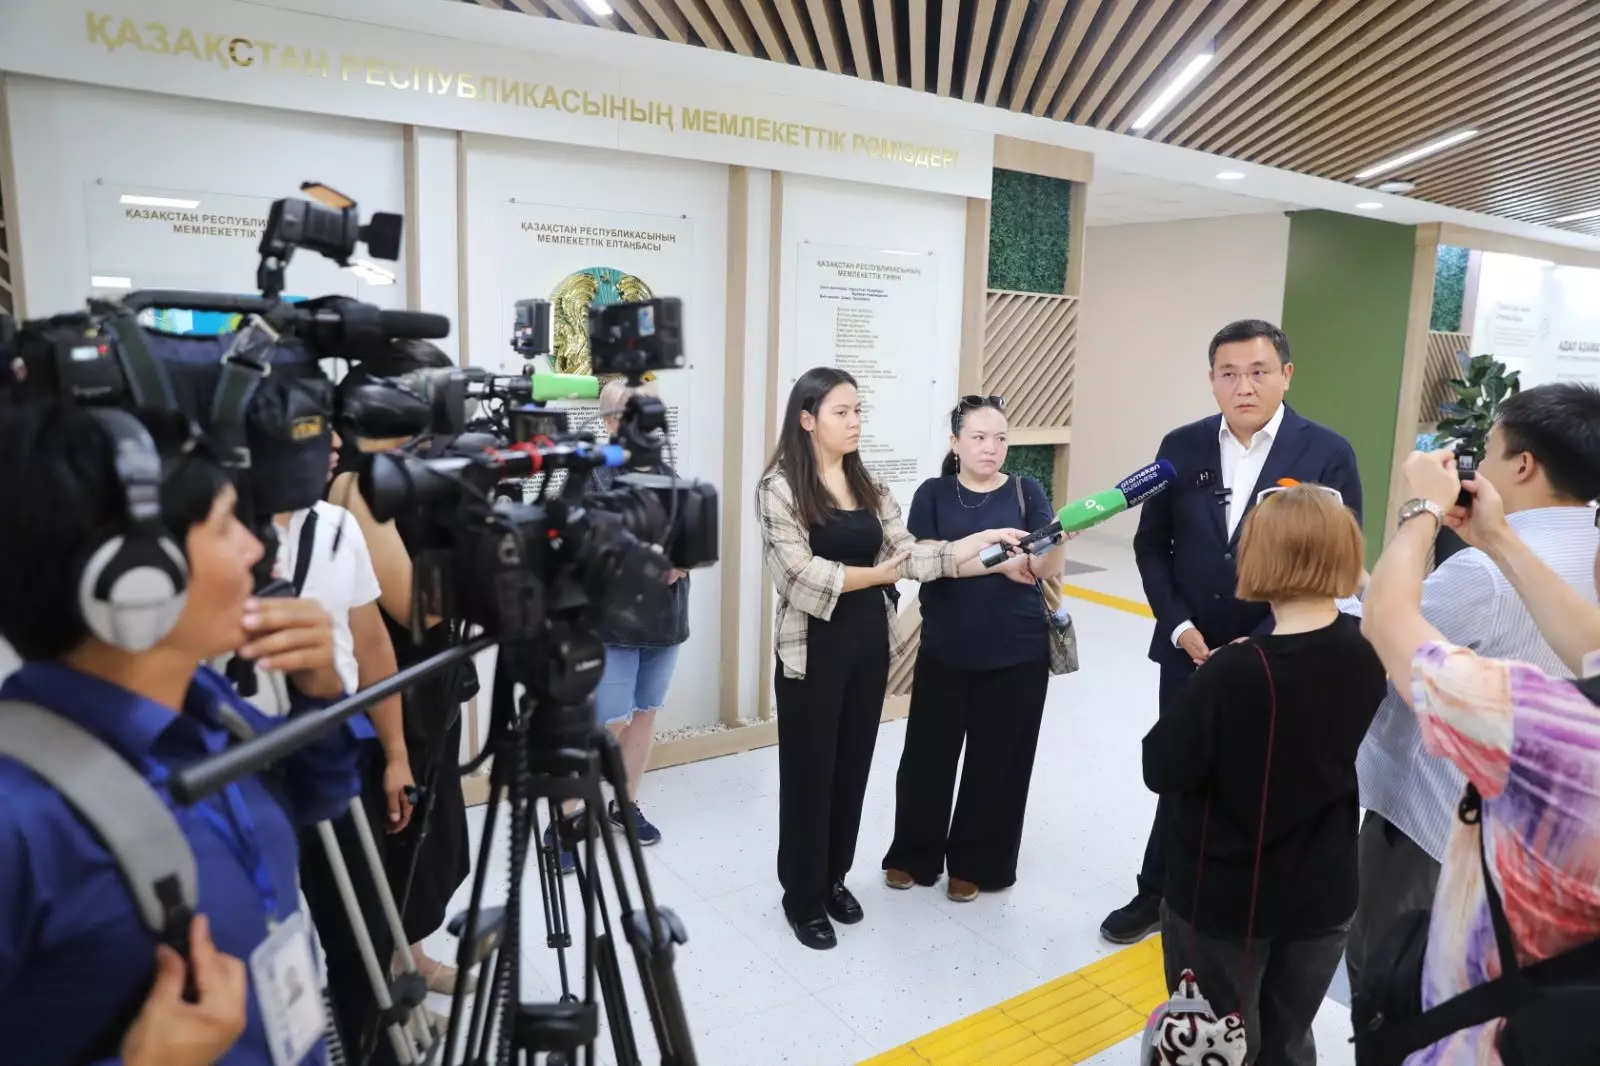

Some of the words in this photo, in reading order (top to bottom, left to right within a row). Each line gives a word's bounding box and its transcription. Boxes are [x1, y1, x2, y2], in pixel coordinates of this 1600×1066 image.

[86, 11, 328, 79] ҚАЗАҚСТАН
[341, 54, 674, 133] РЕСПУБЛИКАСЫНЫҢ
[682, 107, 847, 152] МЕМЛЕКЕТТІК
[125, 208, 199, 223] ҚАЗАҚСТАН
[202, 214, 268, 228] РЕСПУБЛИ
[173, 224, 257, 238] МЕМЛЕКЕТТІК
[521, 221, 577, 234] ҚАЗАҚСТАН
[579, 226, 676, 243] РЕСПУБЛИКАСЫНЫҢ
[537, 234, 604, 247] МЕМЛЕКЕТТІК
[606, 240, 662, 251] ЕЛТАҢБАСЫ
